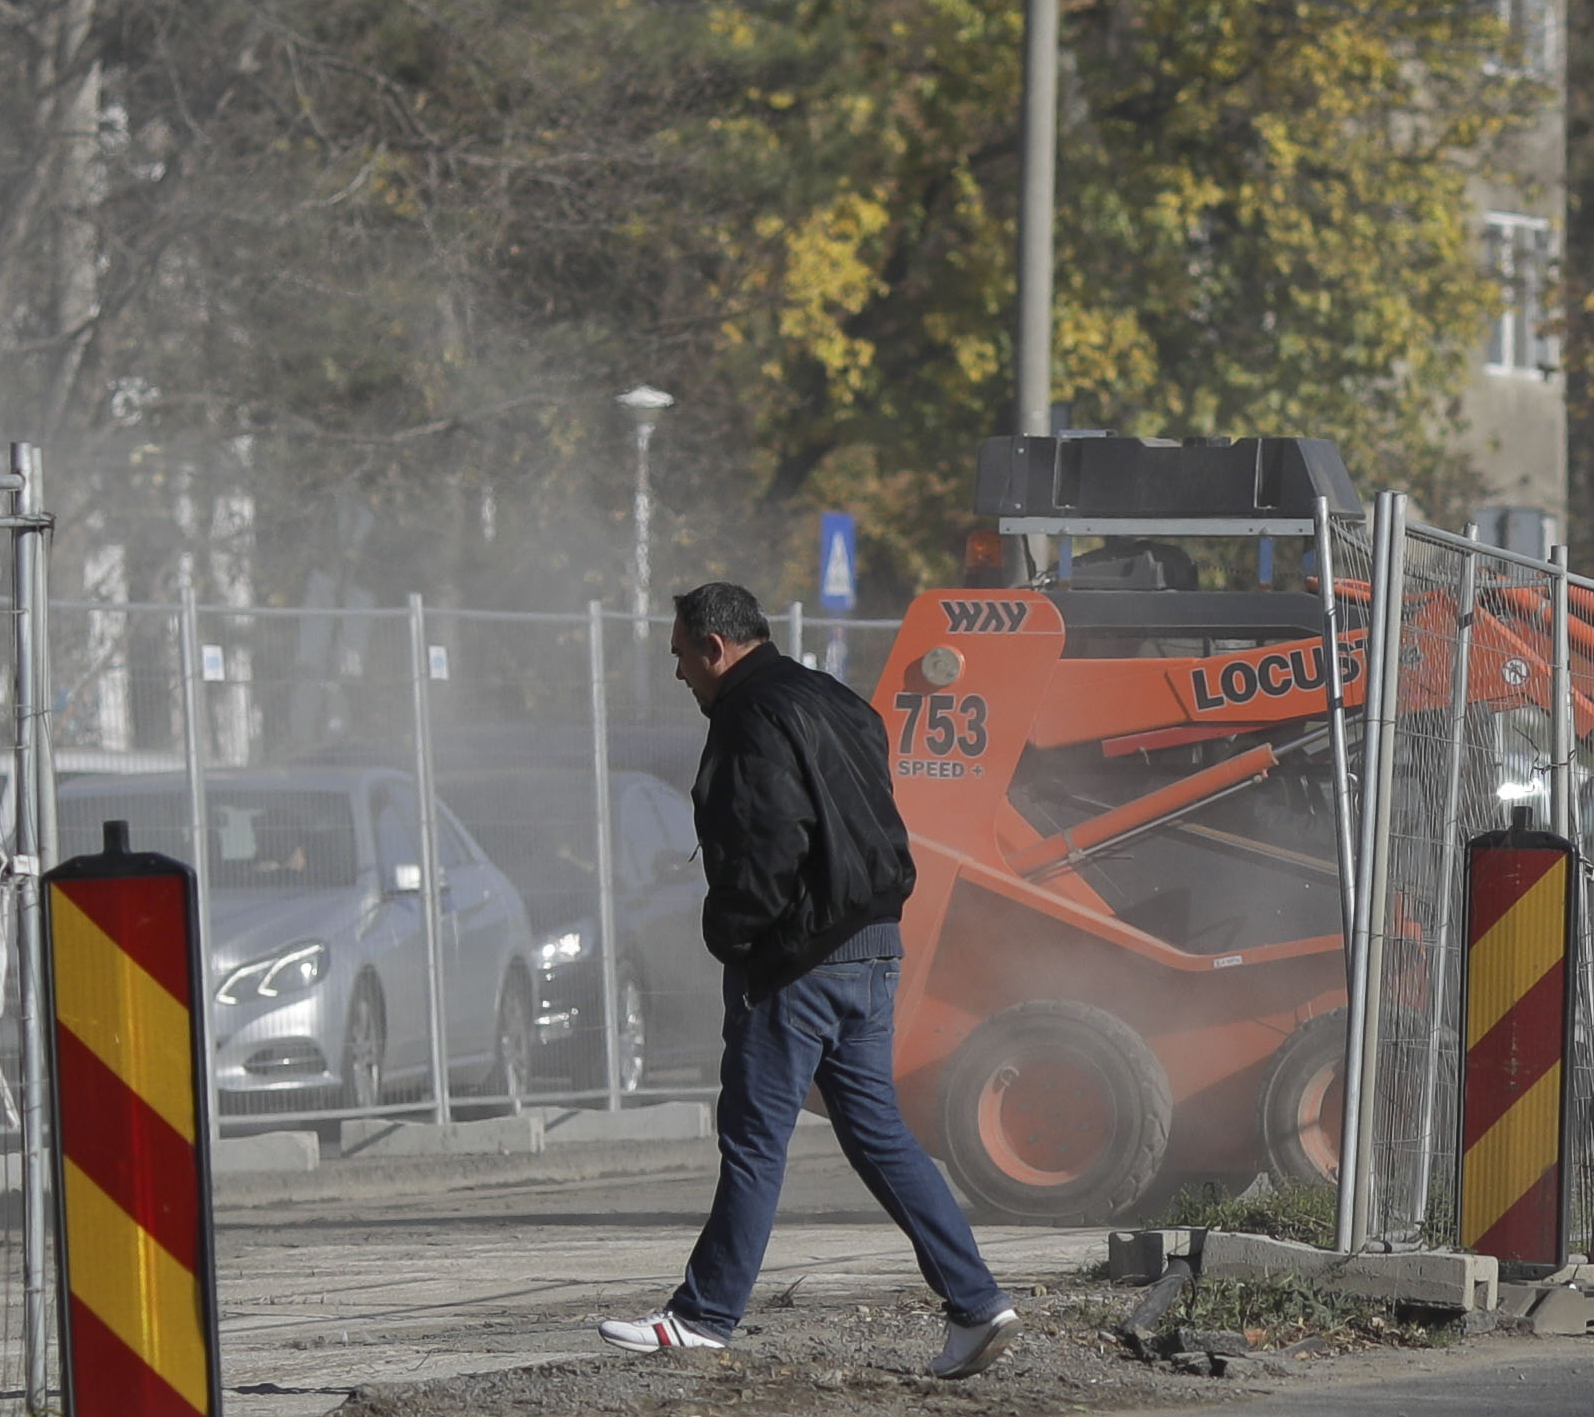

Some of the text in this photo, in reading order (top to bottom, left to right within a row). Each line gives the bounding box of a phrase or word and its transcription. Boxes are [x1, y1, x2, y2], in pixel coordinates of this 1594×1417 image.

[941, 600, 1029, 633] WAY
[1191, 636, 1370, 712] LOCUS
[894, 691, 989, 758] 753
[897, 759, 965, 779] SPEED
